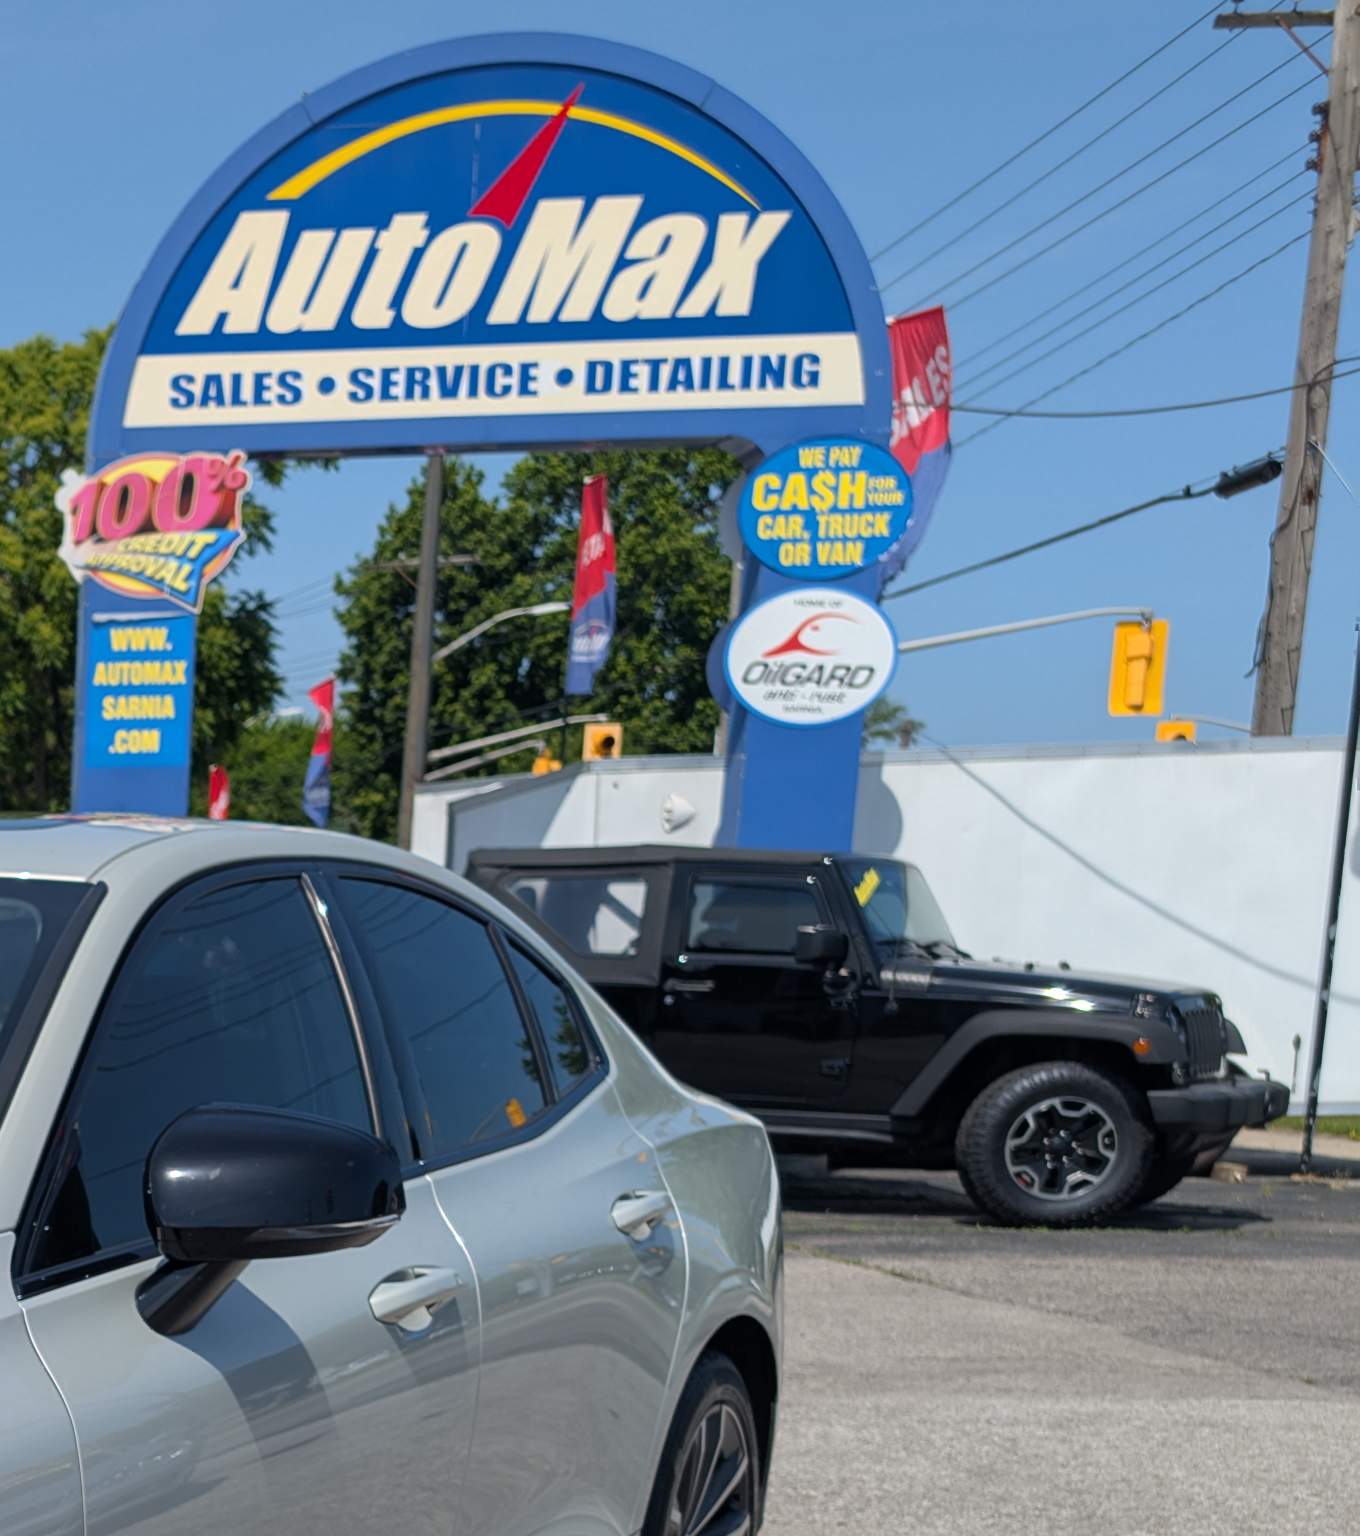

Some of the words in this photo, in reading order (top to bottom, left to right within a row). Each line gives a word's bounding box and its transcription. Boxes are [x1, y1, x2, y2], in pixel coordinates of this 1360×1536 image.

[175, 196, 792, 335] AutoMax
[168, 369, 304, 409] SALES
[347, 361, 540, 403] SERVICE
[584, 352, 822, 397] DETAILING
[799, 447, 826, 468] WE
[829, 445, 862, 468] PAY
[751, 469, 869, 514] CA$H
[869, 475, 897, 490] FOR
[69, 453, 248, 545] 100%
[756, 515, 811, 541] CAR,
[816, 512, 892, 539] TRUCK
[116, 533, 217, 560] CREDIT
[778, 541, 811, 567] OR
[816, 540, 864, 567] VAN
[109, 627, 173, 652] WWW.
[93, 660, 188, 686] AUTOMAX
[102, 694, 176, 720] SARNIA
[108, 728, 161, 754] .COM
